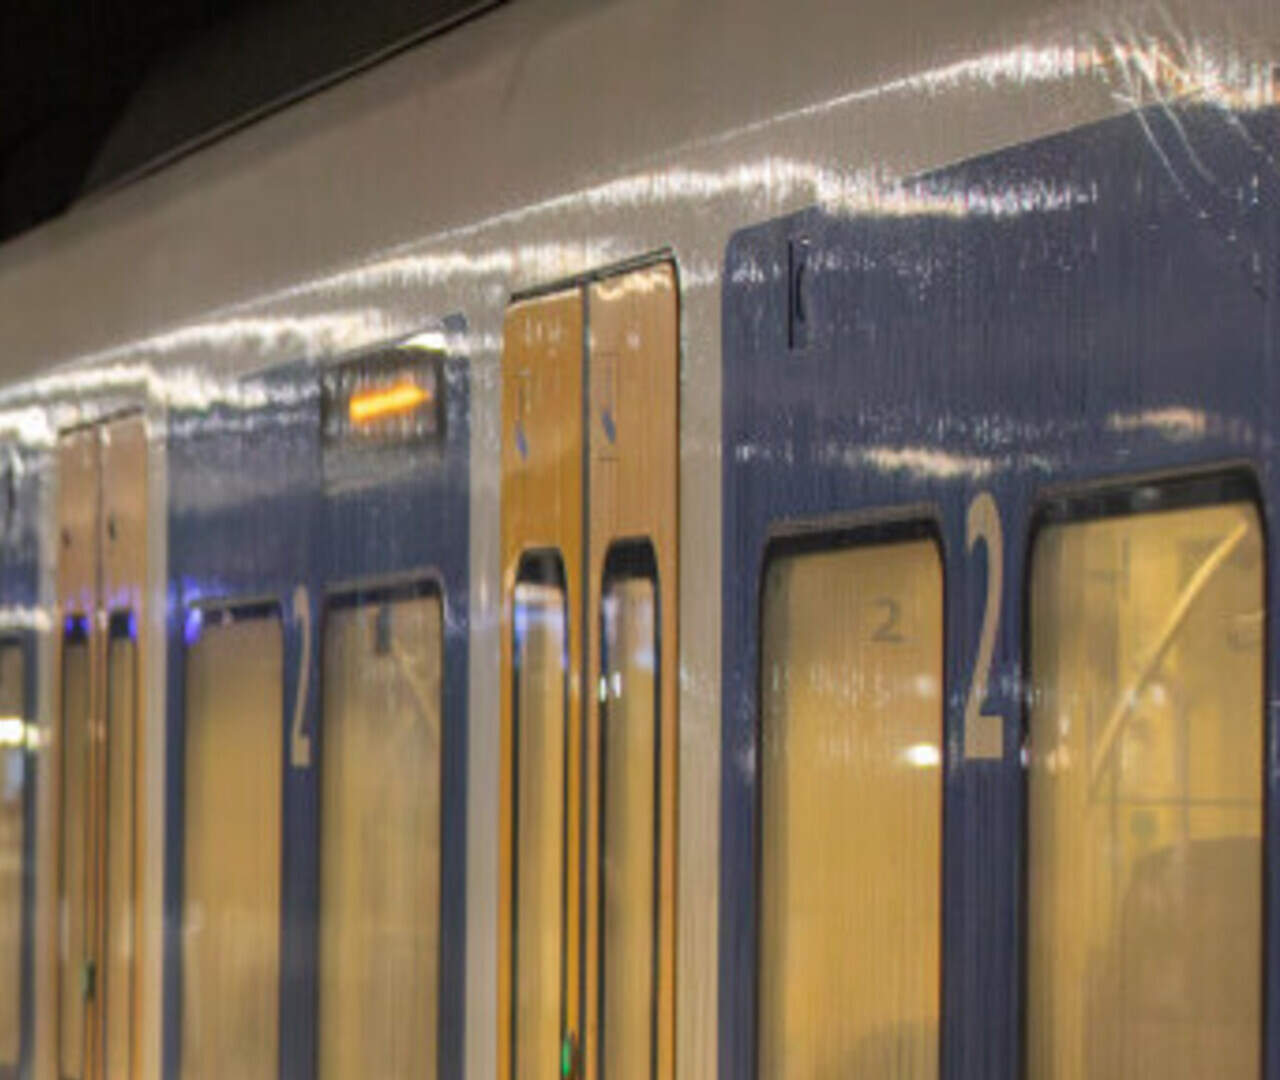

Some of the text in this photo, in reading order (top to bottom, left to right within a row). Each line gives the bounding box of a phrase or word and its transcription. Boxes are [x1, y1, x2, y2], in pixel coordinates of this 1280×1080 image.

[292, 585, 310, 767] 2
[870, 599, 902, 642] 2
[965, 492, 1003, 758] 2
